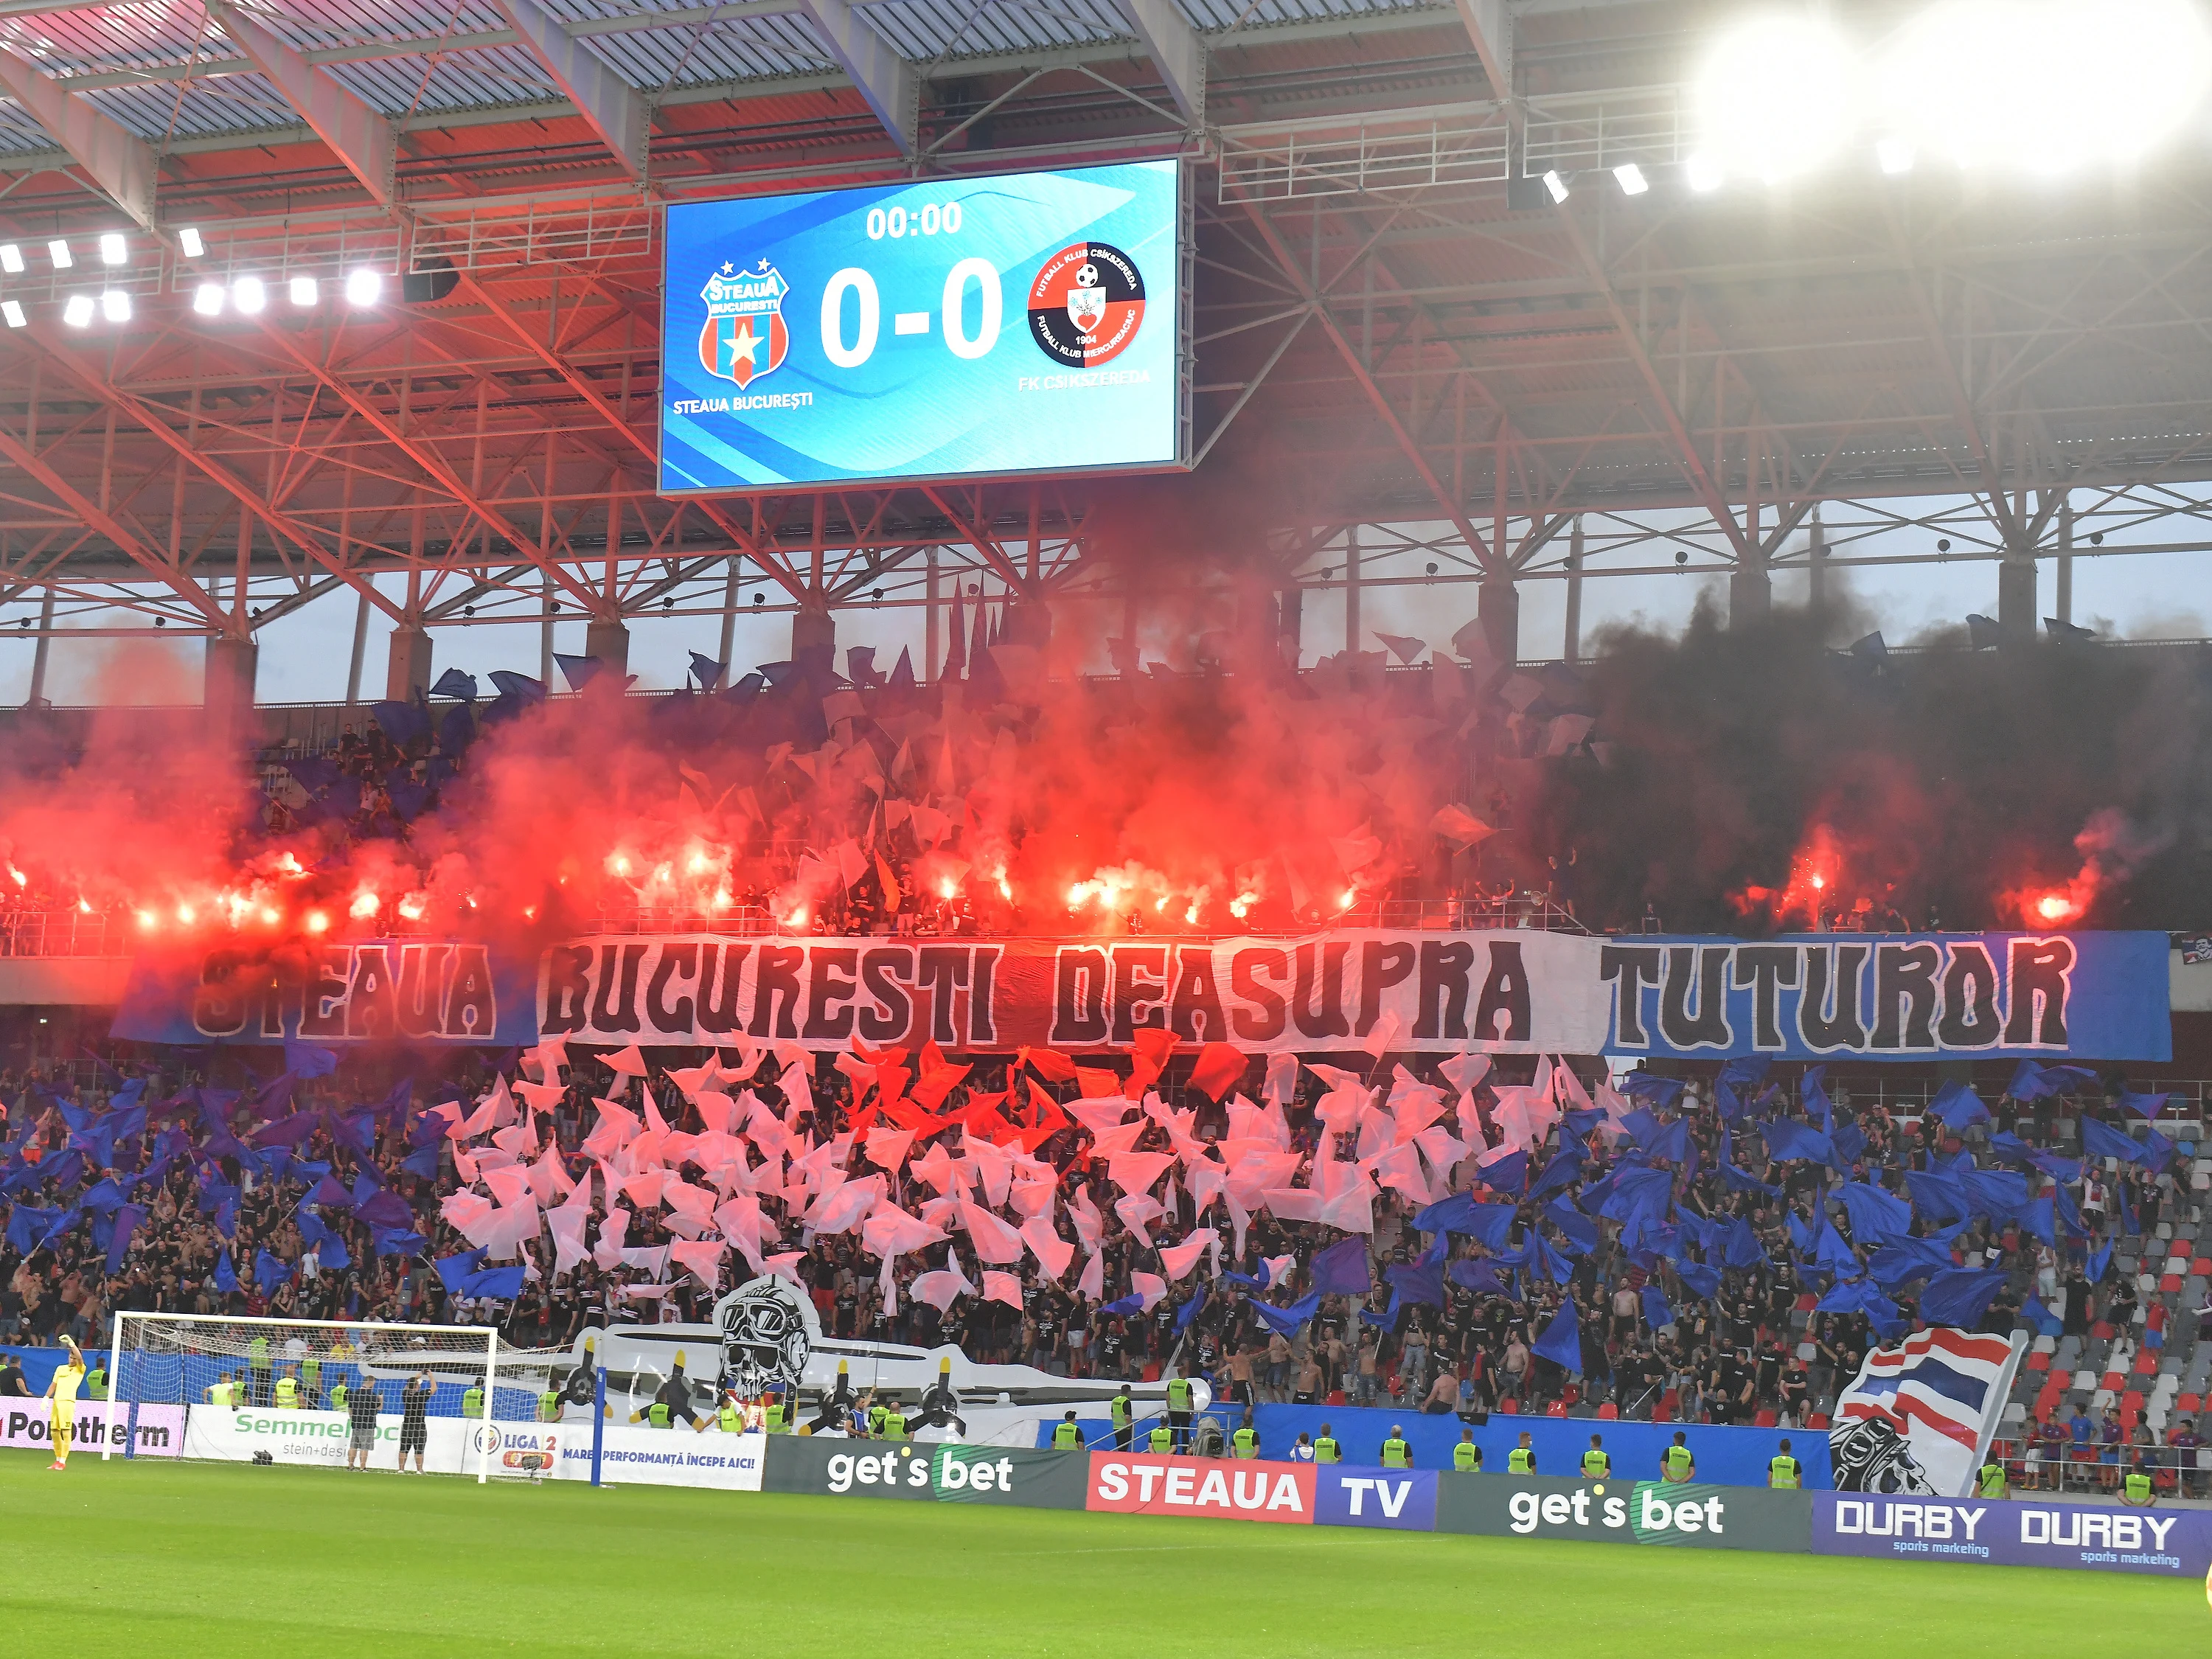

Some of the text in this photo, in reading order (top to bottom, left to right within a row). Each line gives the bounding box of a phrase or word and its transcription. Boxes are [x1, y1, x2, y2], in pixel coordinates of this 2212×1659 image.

[866, 201, 962, 240] 00:00
[709, 276, 780, 302] STEAUA
[1035, 260, 1065, 298] FUTBALL
[1063, 248, 1089, 264] KLUB
[1037, 315, 1060, 350] FUTBALL
[1059, 344, 1082, 358] KLUB
[1075, 334, 1097, 345] 1904
[1018, 377, 1040, 392] FK
[672, 397, 730, 415] STEAUA
[539, 942, 1001, 1047] BUCURESTI
[1048, 940, 1531, 1046] DEASUPRA
[1600, 934, 2078, 1052] TUTUROR
[504, 1434, 557, 1451] LIGA 2
[563, 1448, 594, 1460] MARE
[686, 1454, 726, 1468] ÎNCEPE
[727, 1457, 756, 1470] AICI!
[941, 1451, 1014, 1492] bet
[1097, 1462, 1413, 1518] STEAUA TV
[1641, 1489, 1725, 1534] bet
[1835, 1499, 2177, 1551] DURBY DURBY
[1893, 1540, 1989, 1558] sports marketing
[2080, 1551, 2180, 1569] sports marketing
